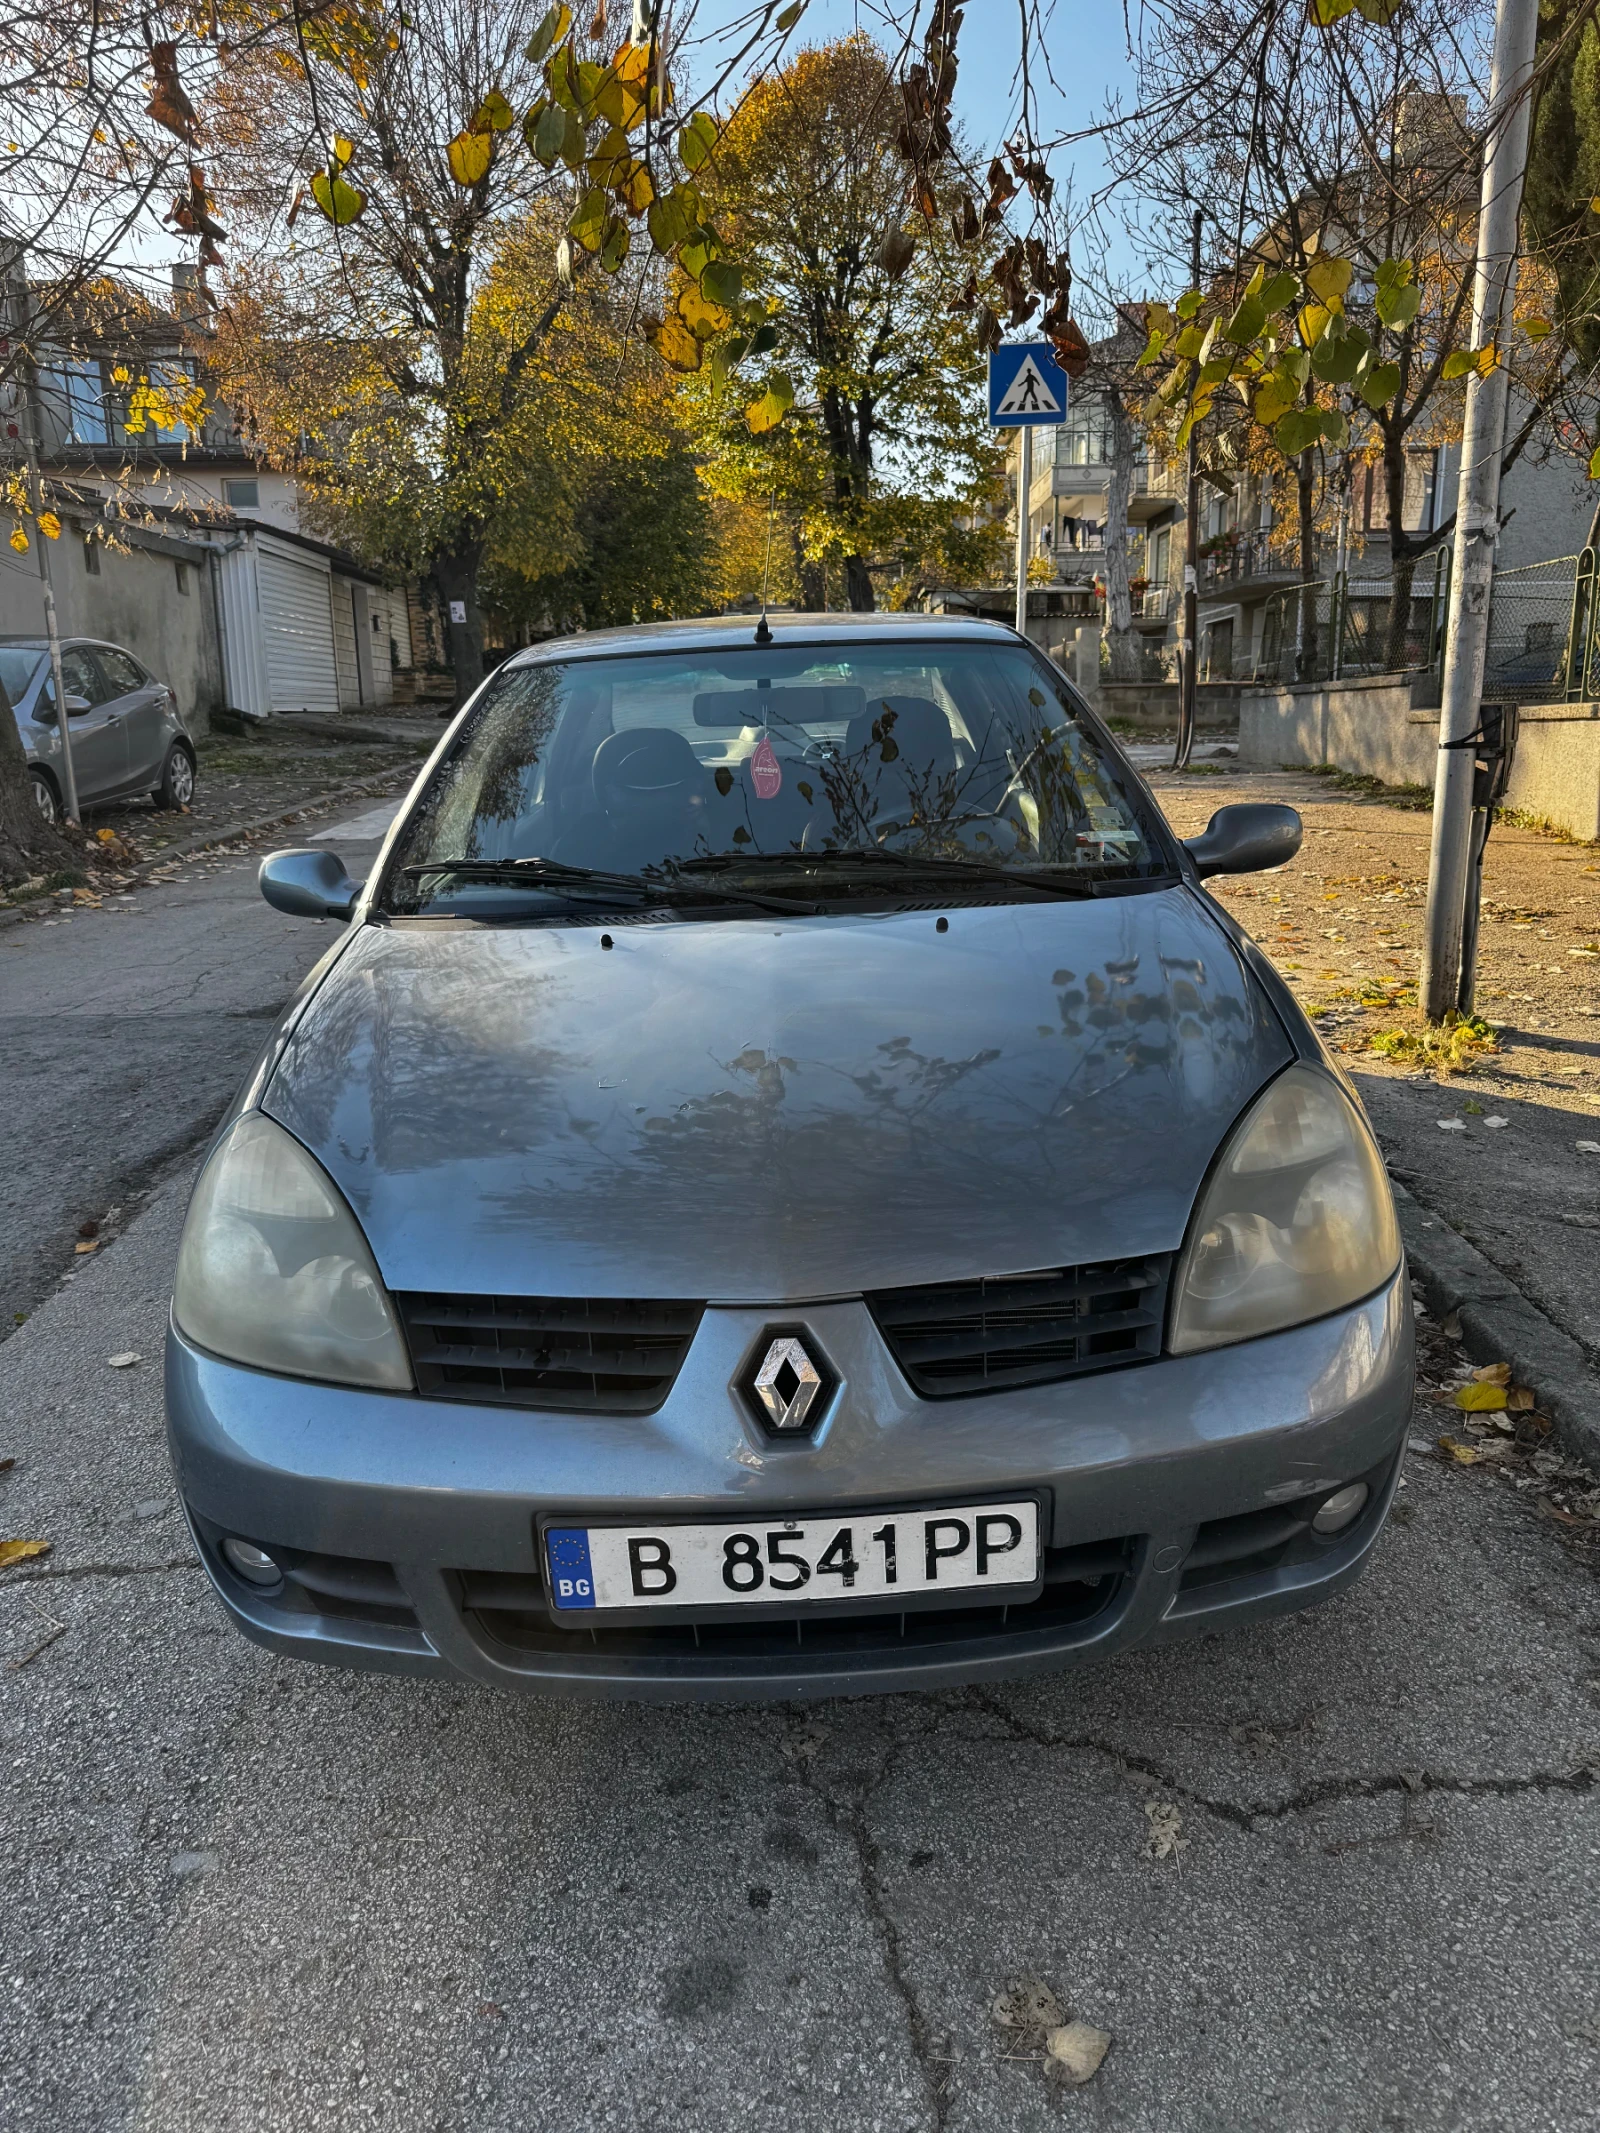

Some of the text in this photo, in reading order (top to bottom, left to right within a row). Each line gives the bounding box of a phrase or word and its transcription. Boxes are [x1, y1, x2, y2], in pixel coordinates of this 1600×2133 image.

[627, 1513, 1021, 1597] B 8541 PP
[560, 1579, 591, 1597] BG
